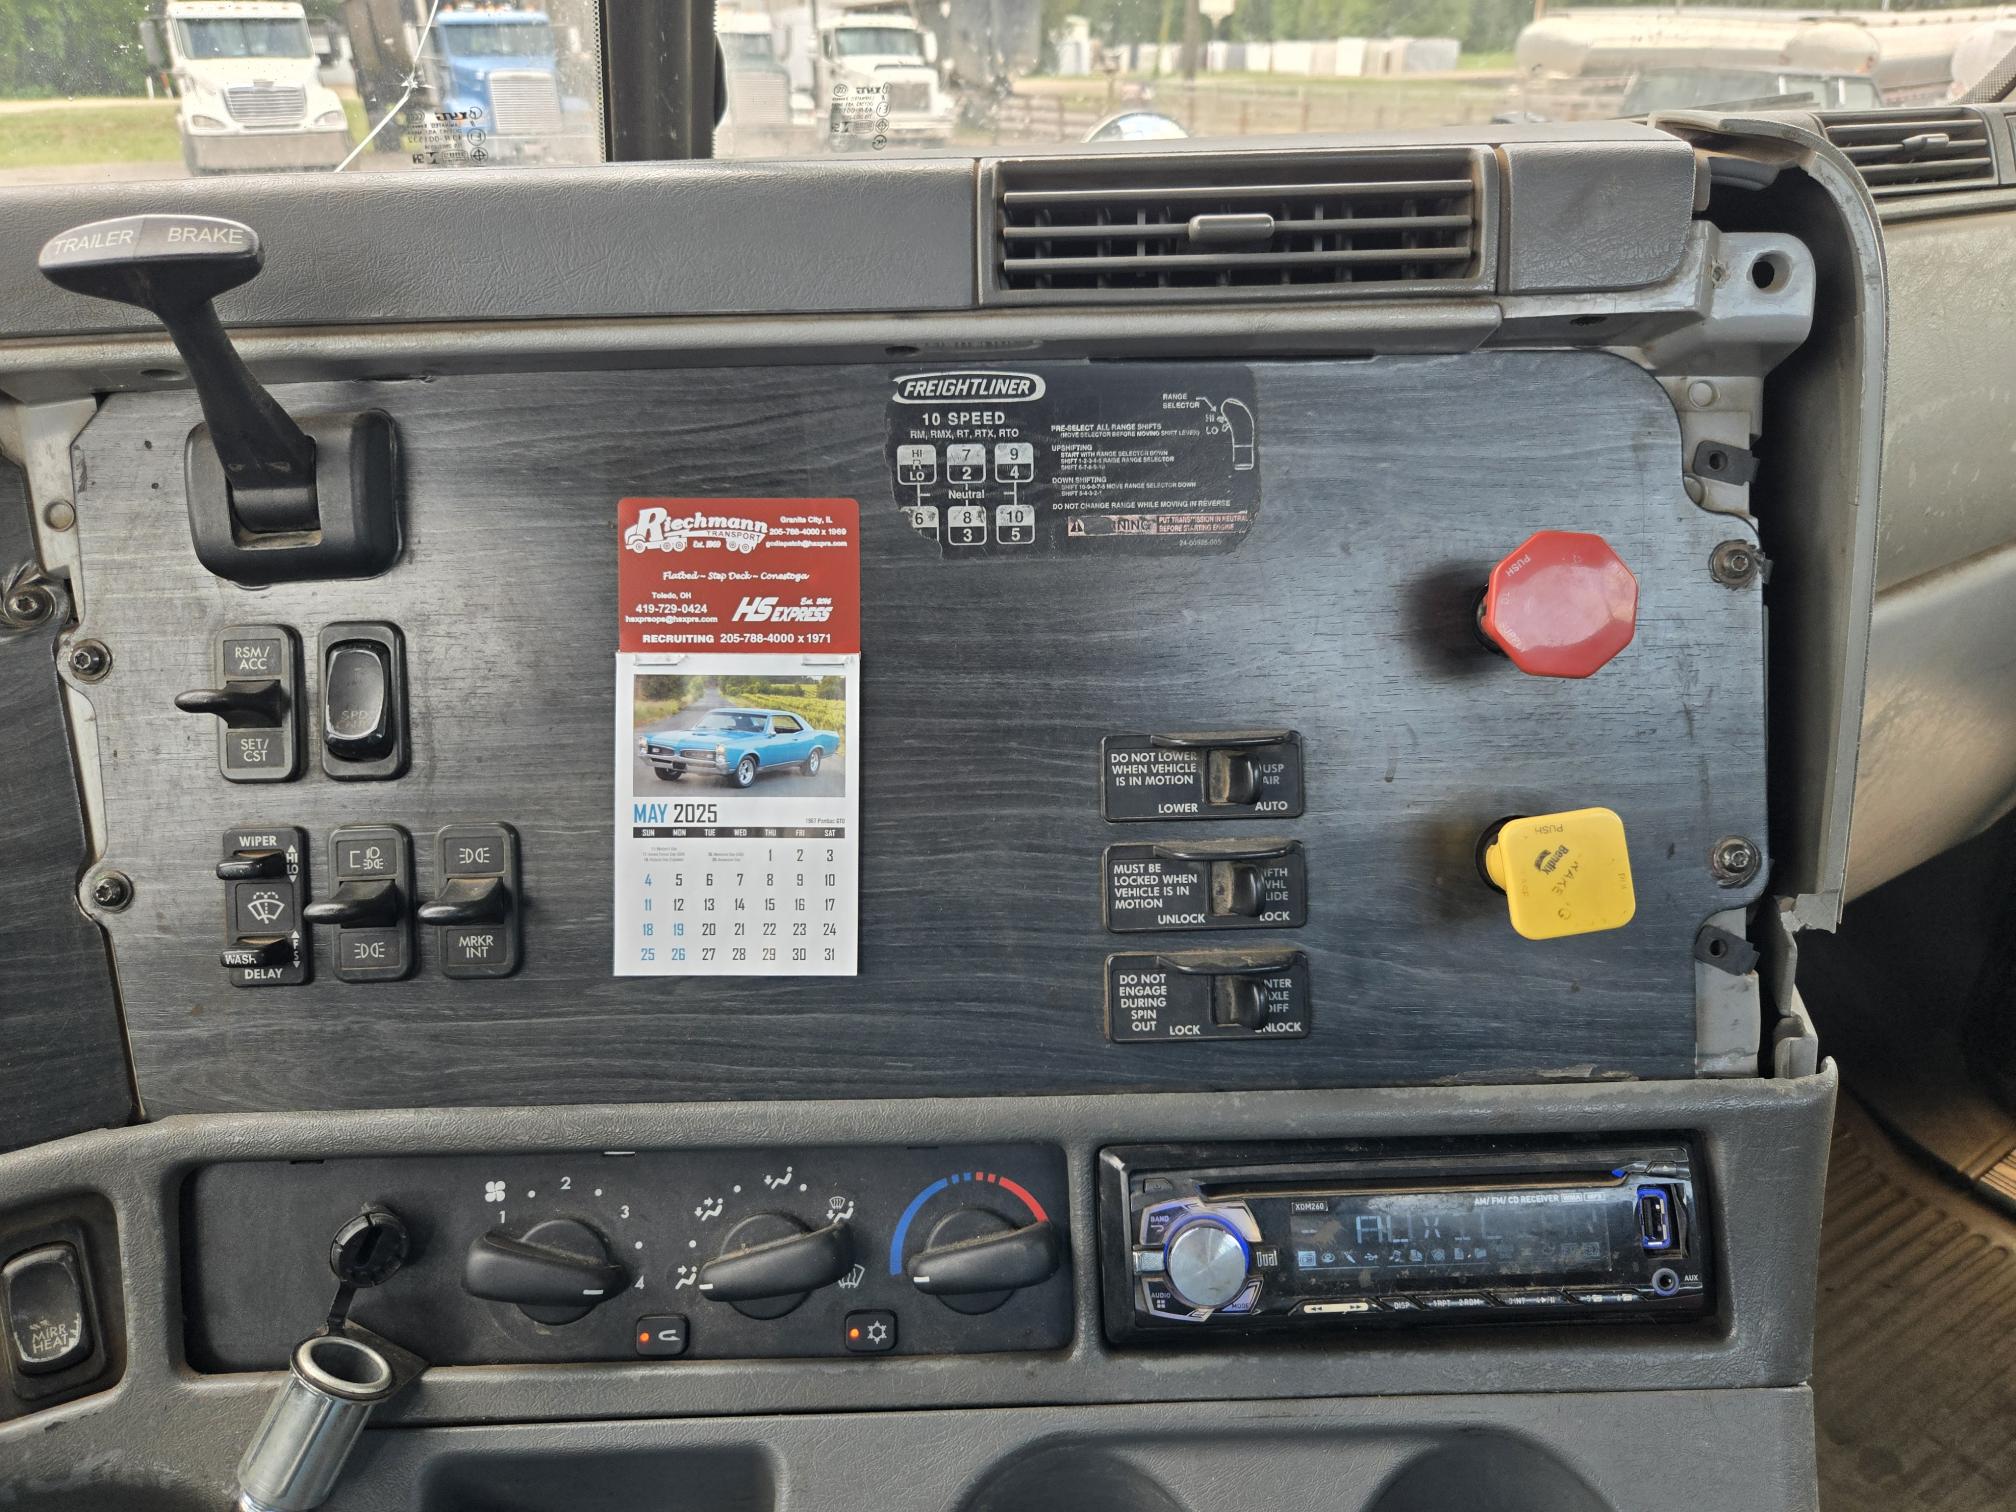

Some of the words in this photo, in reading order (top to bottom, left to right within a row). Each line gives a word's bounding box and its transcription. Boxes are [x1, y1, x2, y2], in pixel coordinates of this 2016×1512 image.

[55, 230, 134, 254] TRAILER
[167, 227, 244, 244] BRAKE
[904, 379, 1030, 397] FREIGHTLINER
[923, 413, 940, 425] 10
[948, 412, 1005, 425] SPEED
[910, 430, 928, 439] RM,
[930, 430, 954, 439] RMX,
[957, 430, 972, 438] RT,
[975, 429, 996, 438] RTX,
[999, 429, 1019, 437] RTO
[912, 450, 922, 458] HI
[962, 449, 971, 461] 7
[1010, 448, 1018, 460] 9
[910, 472, 924, 481] LO
[962, 467, 972, 480] 2
[1010, 466, 1019, 478] 4
[948, 490, 985, 499] Neutral
[915, 512, 923, 525] 6
[963, 512, 972, 524] 8
[1007, 511, 1023, 523] 10
[639, 507, 768, 542] Riechmann
[706, 530, 762, 541] TRANSPORT
[963, 529, 972, 542] 3
[1011, 528, 1020, 541] 5
[1506, 554, 1532, 576] PUSH
[652, 592, 678, 600] Toledo,
[635, 604, 707, 614] 419-729-0424
[732, 596, 779, 622] HS
[771, 606, 833, 622] EXPRESS
[642, 634, 714, 644] RECRUITING
[720, 633, 795, 644] 205-788-4000
[807, 634, 831, 644] 1971
[235, 646, 270, 659] RSM/
[240, 658, 267, 670] ACC
[240, 738, 270, 750] SET/
[244, 751, 267, 762] CST
[1111, 753, 1128, 763] DO
[1131, 753, 1155, 762] NOT
[1158, 752, 1197, 762] LOWER
[1112, 764, 1148, 774] WHEN
[1151, 763, 1196, 774] VEHICLE
[1263, 764, 1285, 774] USP
[1116, 776, 1125, 786] IS
[1129, 776, 1142, 785] IN
[1145, 775, 1194, 785] MOTION
[1158, 803, 1198, 813] LOWER
[1255, 801, 1288, 811] AUTO
[634, 803, 668, 823] MAY
[673, 803, 718, 823] 2025
[642, 829, 655, 837] SUN
[673, 829, 686, 837] MON
[704, 829, 716, 837] TUE
[734, 829, 747, 837] WED
[765, 829, 777, 837] THU
[796, 829, 805, 837] FRI
[825, 829, 836, 837] SAT
[239, 836, 276, 847] WIPER
[286, 853, 298, 863] HI
[768, 849, 773, 862] 1
[796, 849, 804, 862] 2
[827, 849, 833, 862] 3
[287, 864, 298, 874] LO
[1114, 864, 1145, 874] MUST
[1149, 864, 1161, 873] BE
[645, 873, 652, 886] 4
[675, 873, 683, 886] 5
[706, 873, 713, 886] 6
[737, 873, 743, 886] 7
[767, 873, 774, 886] 8
[797, 873, 804, 886] 9
[825, 873, 835, 886] 10
[1114, 875, 1158, 886] LOCKED
[1163, 874, 1197, 884] WHEN
[1115, 887, 1159, 897] VEHICLE
[1164, 886, 1173, 896] IS
[1177, 886, 1190, 896] IN
[1265, 892, 1288, 901] LIDE
[644, 898, 652, 911] 11
[673, 898, 684, 911] 12
[704, 898, 715, 911] 13
[735, 898, 745, 911] 14
[765, 898, 775, 911] 15
[795, 898, 805, 911] 16
[825, 898, 835, 911] 17
[1115, 899, 1163, 909] MOTION
[1158, 914, 1205, 924] UNLOCK
[1260, 911, 1290, 922] LOCK
[643, 923, 653, 936] 18
[673, 923, 684, 936] 19
[702, 923, 716, 936] 20
[734, 923, 745, 936] 21
[763, 923, 776, 936] 22
[793, 923, 806, 936] 23
[823, 923, 836, 936] 24
[293, 939, 298, 949] F
[459, 935, 494, 947] MRKR
[293, 951, 299, 961] S
[466, 947, 488, 958] INT
[641, 948, 655, 961] 25
[672, 948, 685, 961] 26
[702, 948, 715, 961] 27
[732, 948, 745, 961] 28
[762, 948, 776, 961] 29
[792, 948, 806, 961] 30
[825, 948, 835, 961] 31
[225, 954, 257, 965] WASH
[244, 968, 283, 979] DELAY
[1119, 975, 1137, 985] DO
[1141, 973, 1166, 984] NOT
[1264, 978, 1292, 988] NTER
[1119, 986, 1167, 996] ENGAGE
[1121, 998, 1167, 1008] DURING
[1131, 1009, 1156, 1019] SPIN
[1132, 1021, 1156, 1031] OUT
[1169, 1025, 1200, 1036] LOCK
[561, 1177, 572, 1190] 2
[1508, 1195, 1519, 1204] CD
[1520, 1194, 1560, 1204] RECEIVER
[499, 1210, 507, 1224] 1
[620, 1205, 630, 1219] 3
[1256, 1250, 1278, 1267] Dual
[635, 1275, 645, 1289] 4
[1684, 1274, 1698, 1282] AUX
[1231, 1302, 1250, 1310] MODE
[1394, 1301, 1411, 1311] DISP
[32, 1323, 67, 1343] MIRR
[33, 1333, 68, 1353] HEAT
